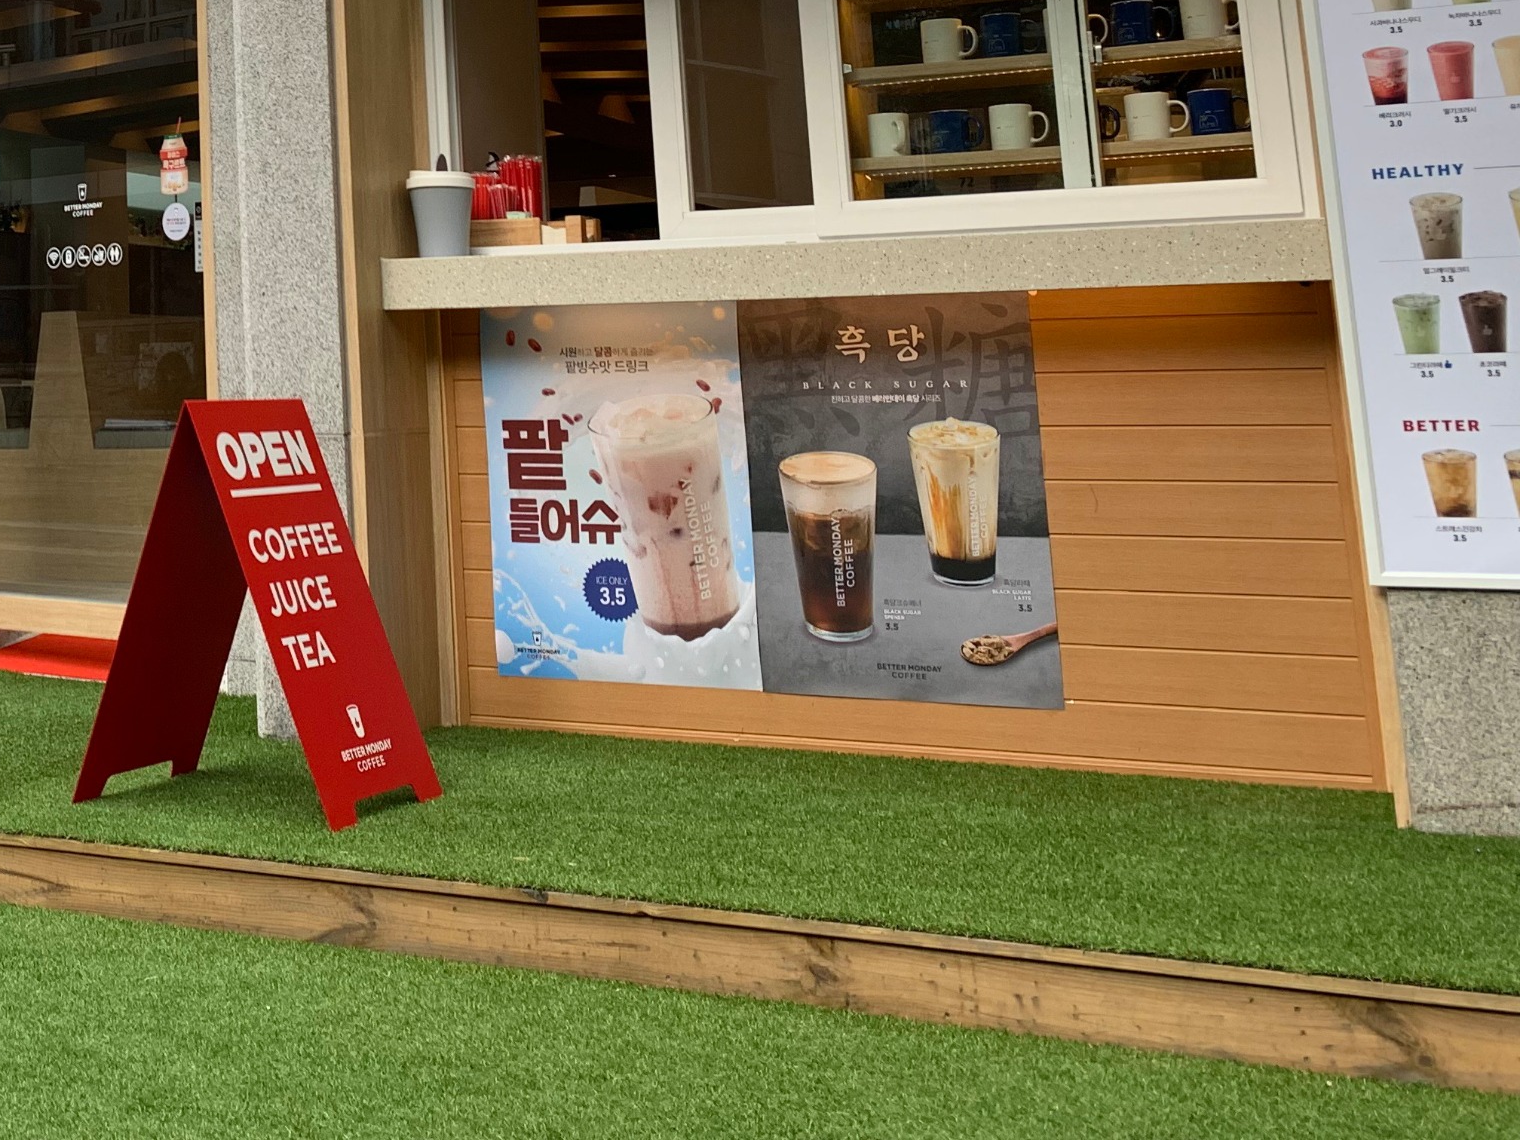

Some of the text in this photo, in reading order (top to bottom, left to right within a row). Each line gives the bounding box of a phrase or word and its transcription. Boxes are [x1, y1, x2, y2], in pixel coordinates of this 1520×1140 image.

[1468, 18, 1482, 27] 3.5
[1390, 26, 1403, 34] 3.5
[1390, 120, 1403, 128] 3.0
[1454, 115, 1468, 123] 3.5
[1372, 163, 1464, 180] HEALTHY
[64, 204, 81, 212] BETTER
[1441, 275, 1454, 283] 3.5
[560, 346, 628, 357] 시원하고 달콤하게
[614, 359, 649, 374] 드링크
[1487, 369, 1501, 377] 3.5
[1420, 370, 1434, 378] 3.5
[802, 380, 968, 390] BLACK SUGAR
[851, 395, 871, 404] 달콤한
[921, 394, 942, 403] 시리즈
[1403, 419, 1480, 432] BETTER
[216, 430, 316, 481] OPEN
[501, 419, 570, 491] 팥
[509, 497, 622, 545] 들어슈
[968, 476, 980, 557] BETTER MONDAY
[980, 494, 988, 539] COFFEE
[682, 478, 712, 600] BETTER MONDAY
[700, 500, 719, 568] COFFEE
[1453, 534, 1467, 542] 3.5
[248, 521, 343, 564] COFFEE
[830, 517, 846, 607] BETTER MONDAY
[844, 538, 855, 588] COFFEE
[596, 576, 628, 585] ICE ONLY
[269, 575, 337, 617] JUICE
[599, 587, 626, 606] 3.5
[1018, 604, 1033, 612] 3.5
[885, 623, 899, 631] 3.5
[281, 630, 337, 671] TEA
[877, 663, 942, 673] BETTER MONDAY
[892, 672, 927, 680] COFFEE
[341, 738, 392, 762] BETTER MONDAY
[357, 754, 386, 772] COFFEE
